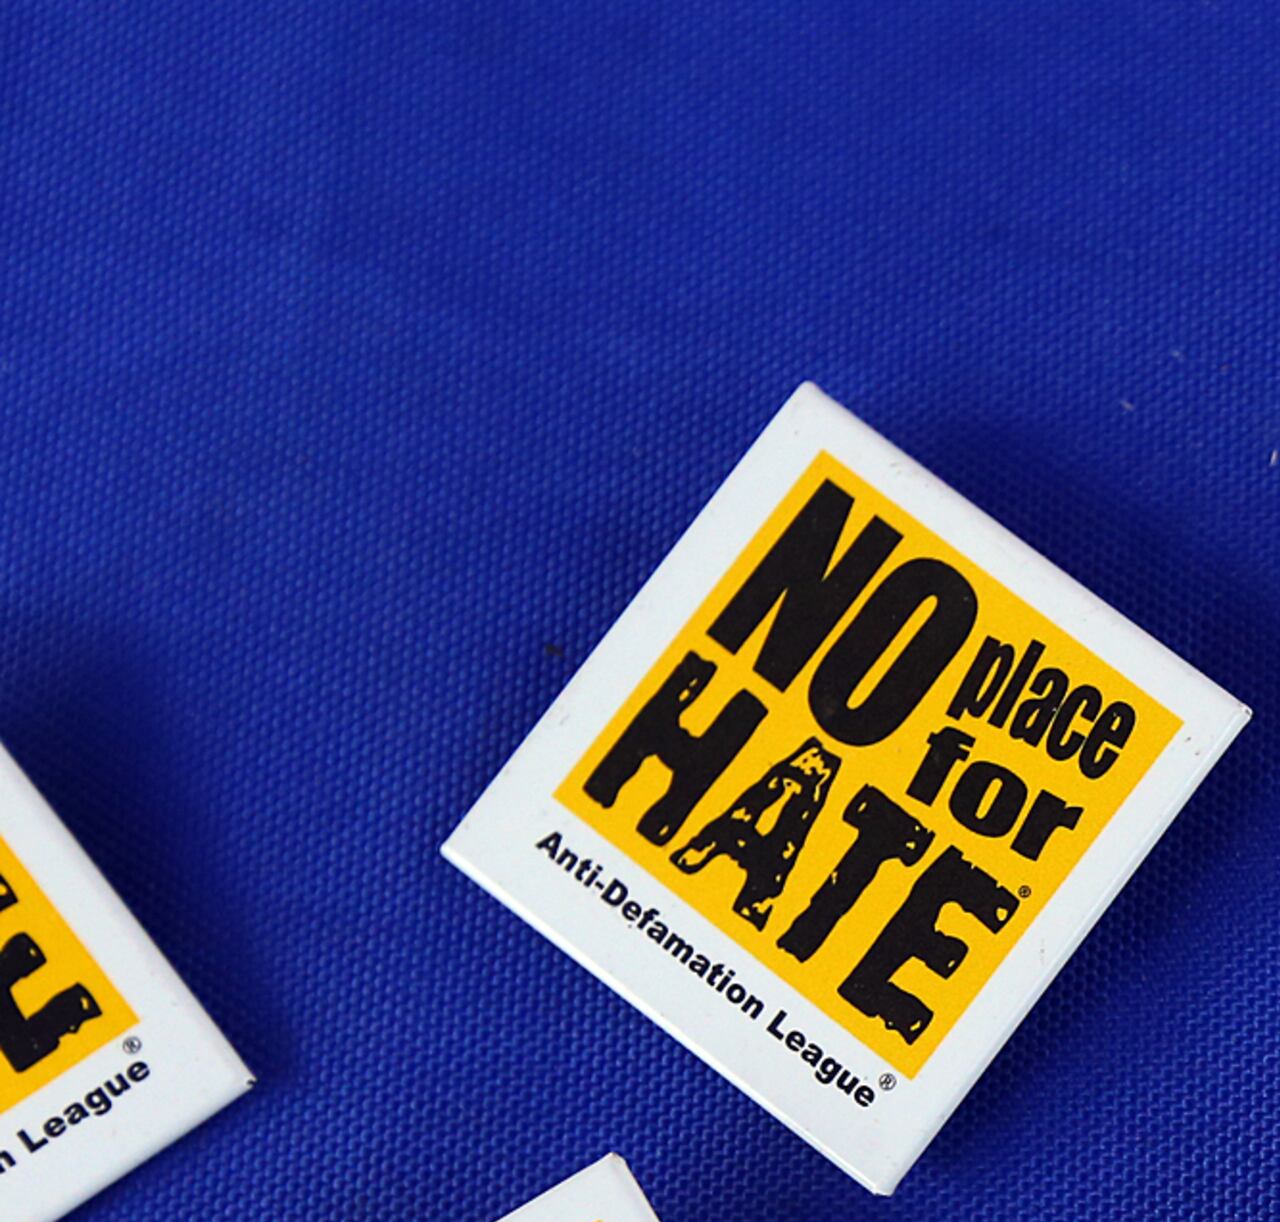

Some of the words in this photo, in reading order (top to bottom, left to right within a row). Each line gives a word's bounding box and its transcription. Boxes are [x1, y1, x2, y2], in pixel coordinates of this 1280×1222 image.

[706, 478, 979, 747] NO
[946, 636, 1136, 779] place
[906, 729, 1083, 862] for
[535, 830, 765, 1021] Anti-Defamation
